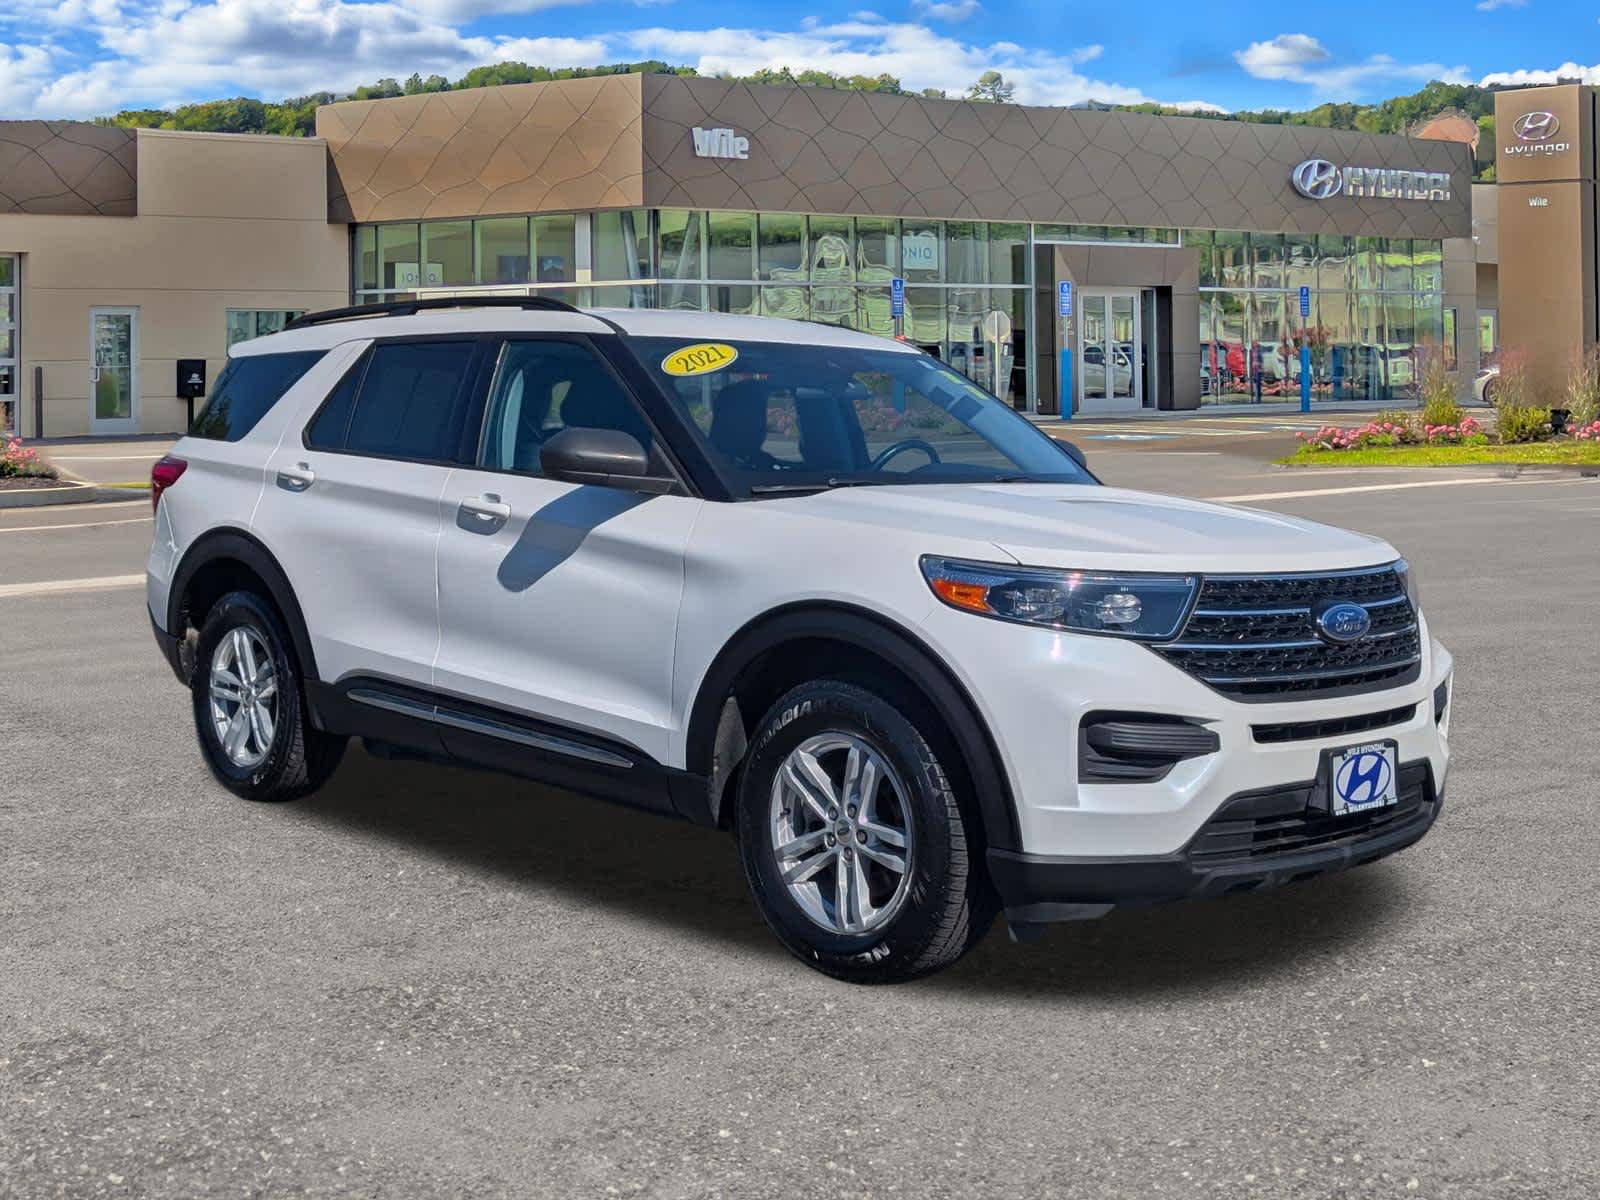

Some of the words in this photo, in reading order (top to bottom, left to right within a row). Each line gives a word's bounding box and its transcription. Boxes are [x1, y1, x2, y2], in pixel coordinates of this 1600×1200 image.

[691, 127, 750, 160] Wile
[1342, 167, 1451, 201] HYUNDAI
[676, 346, 728, 373] 2021
